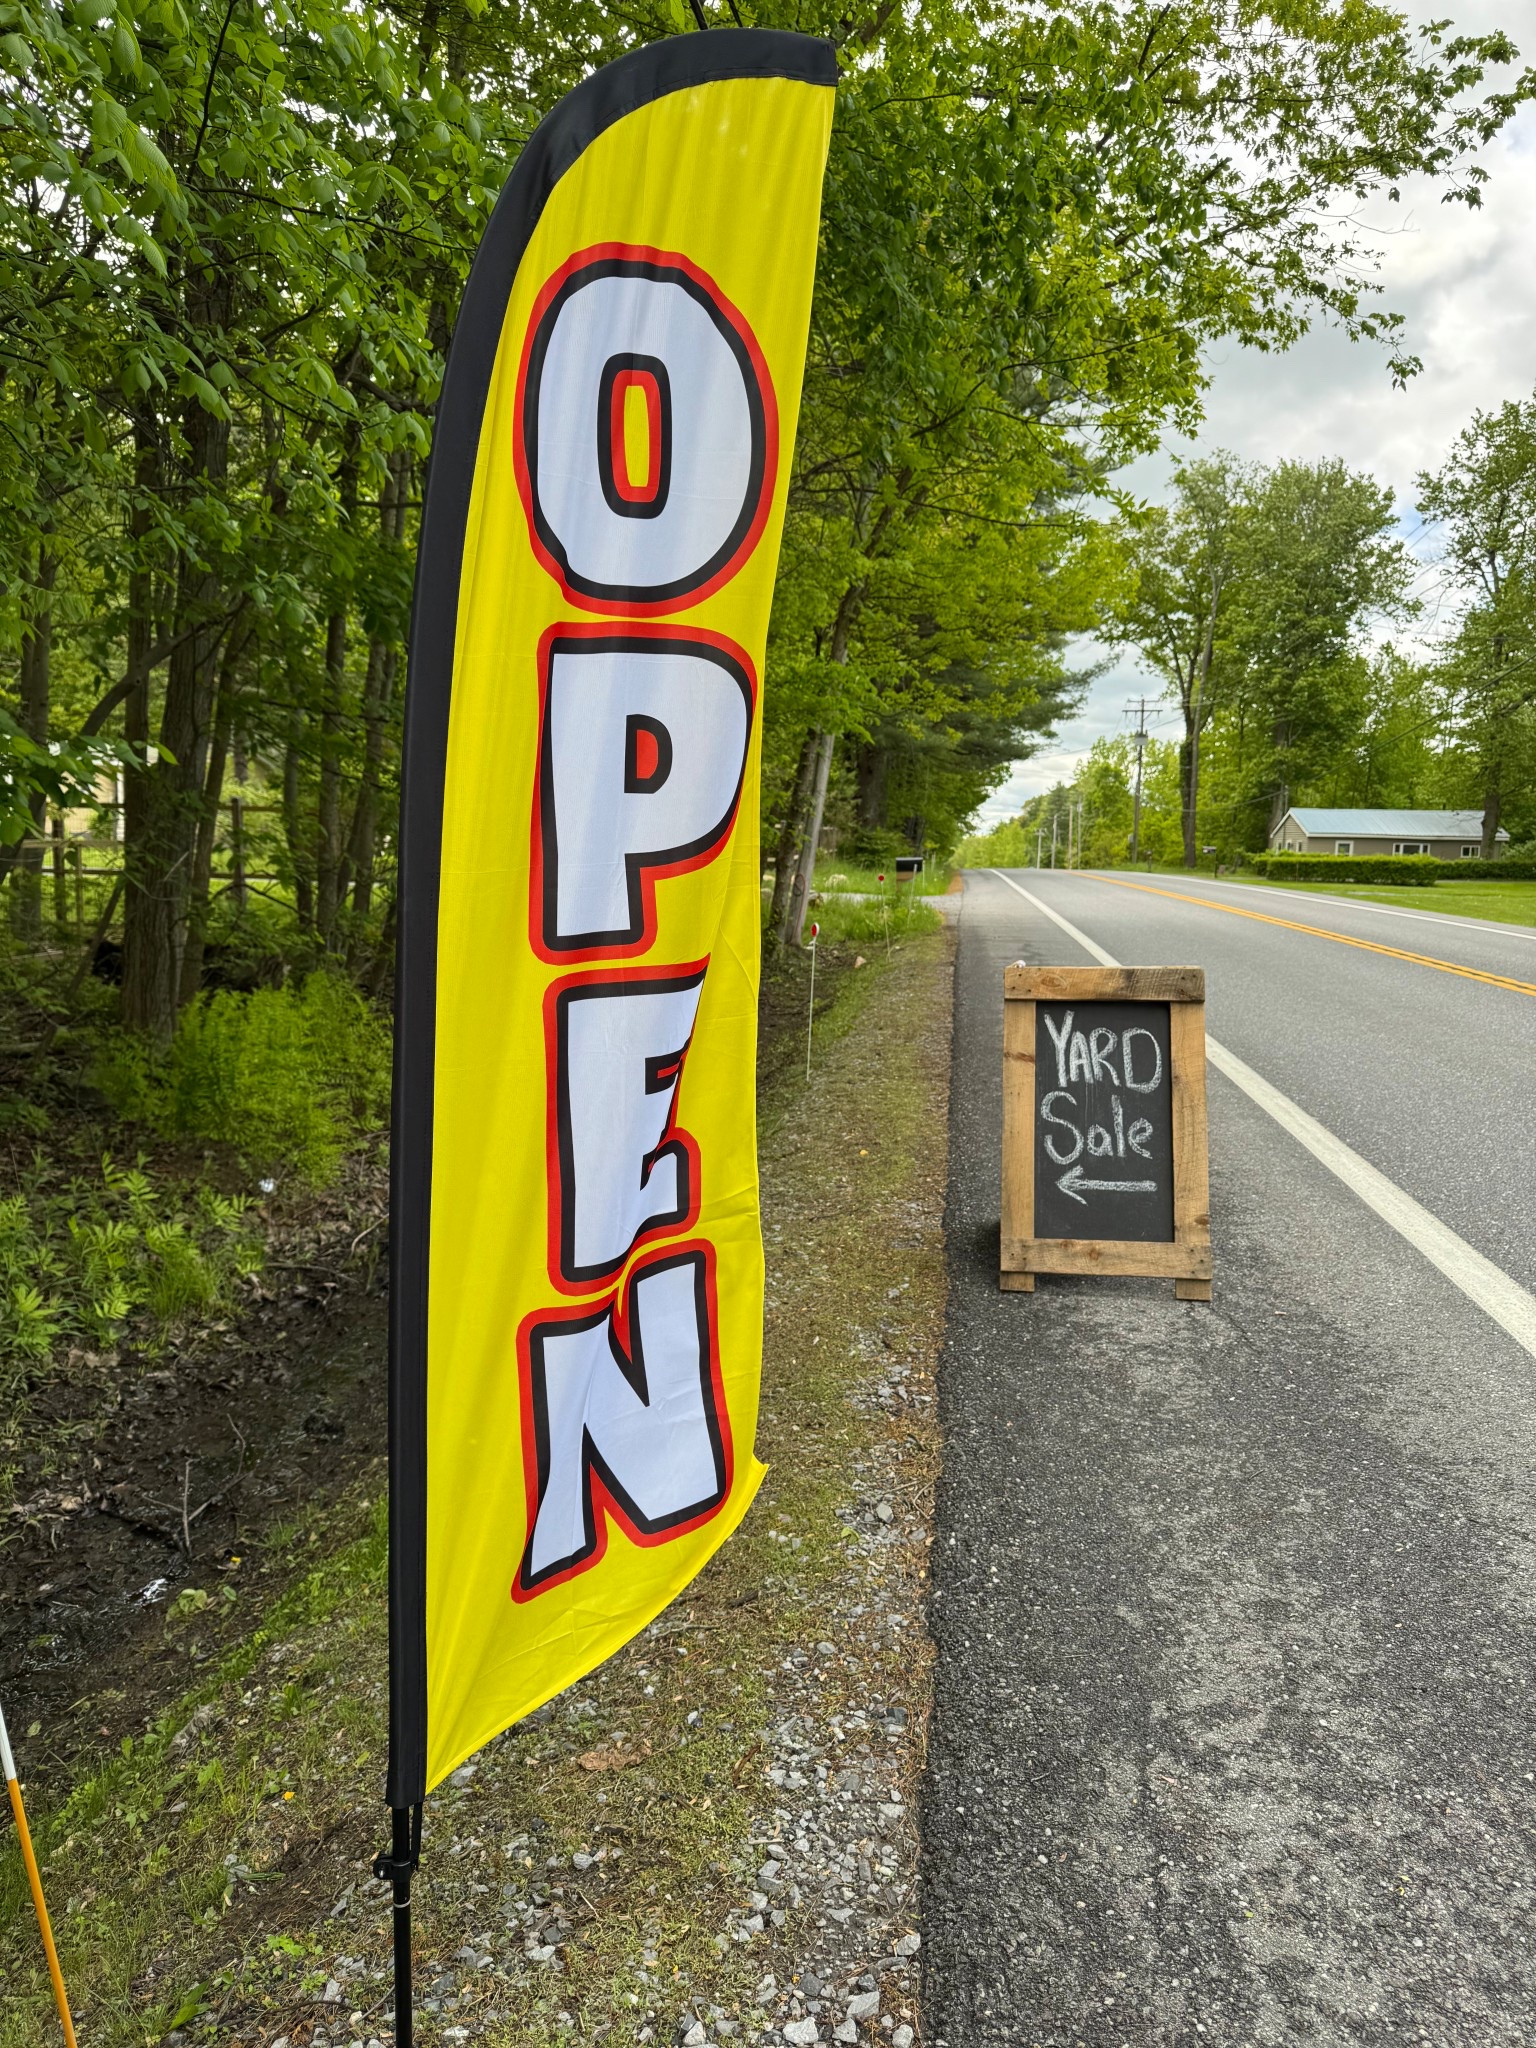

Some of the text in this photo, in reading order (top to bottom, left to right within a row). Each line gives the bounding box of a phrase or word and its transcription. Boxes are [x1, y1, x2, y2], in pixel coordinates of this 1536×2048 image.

[511, 242, 779, 1603] OPEN
[1043, 1009, 1163, 1094] YARD
[1040, 1090, 1154, 1166] Sale
